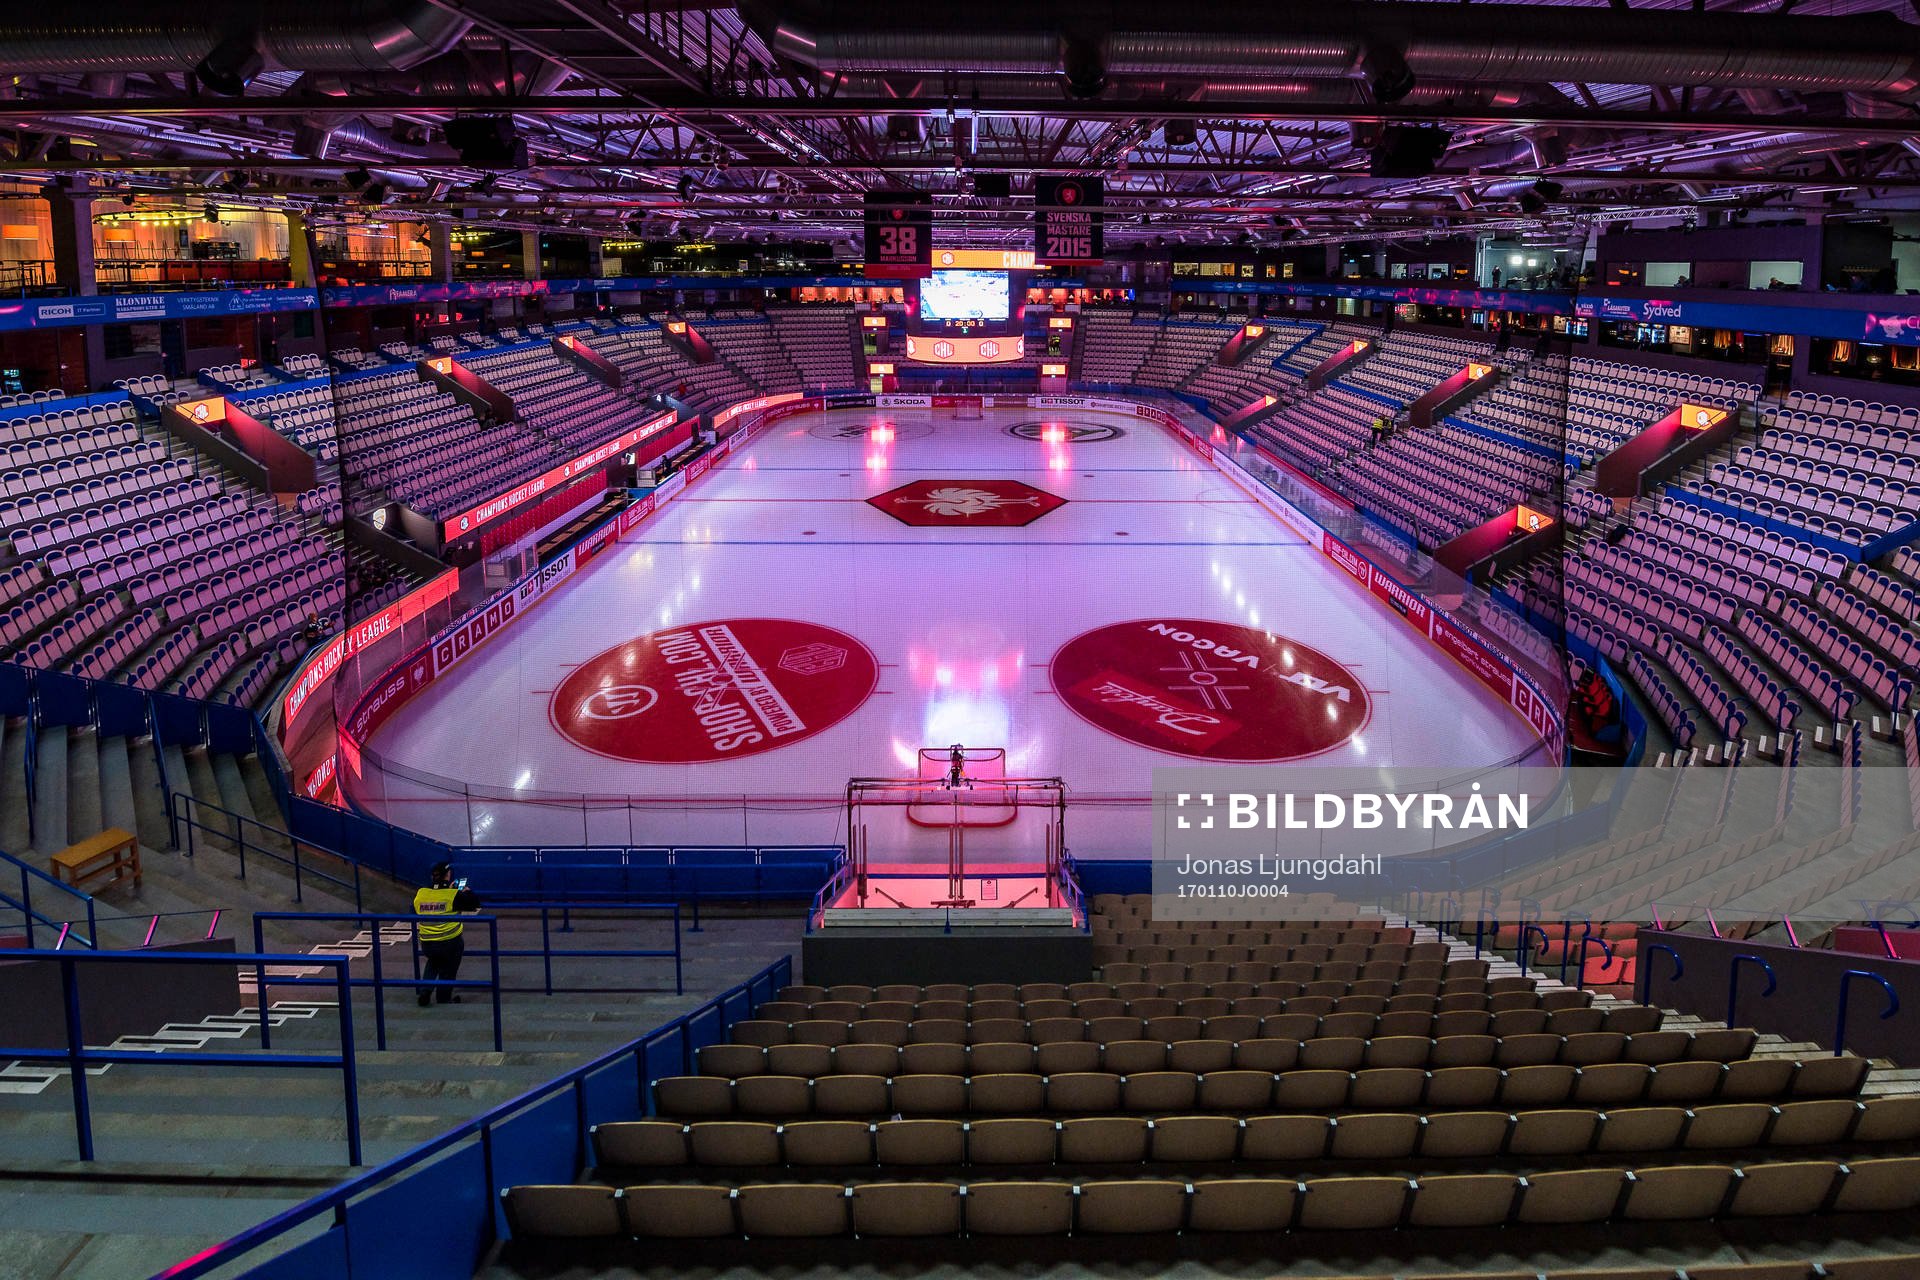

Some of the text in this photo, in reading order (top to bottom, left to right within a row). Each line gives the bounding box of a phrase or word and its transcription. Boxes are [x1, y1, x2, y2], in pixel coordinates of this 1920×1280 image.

[1047, 212, 1092, 223] SVENSKA
[879, 226, 917, 255] 38
[1046, 237, 1092, 257] 2015
[41, 308, 72, 316] RICOH
[115, 296, 165, 307] KLONDYKE
[1643, 303, 1682, 319] Sydved
[934, 343, 953, 358] CHL
[980, 343, 999, 357] CHL
[476, 496, 509, 523] CHAMPIONS
[508, 487, 527, 507] HOCKEY
[528, 478, 546, 496] LEAGUE
[534, 554, 569, 587] TISSOT
[1374, 571, 1426, 618] WARRIOR
[441, 601, 512, 662] CRAMO
[1147, 623, 1260, 669] VAGON
[290, 613, 391, 716] CHAMPIONS HOCKEY LEAGUE
[1480, 657, 1512, 687] strauss
[356, 676, 405, 733] strauss
